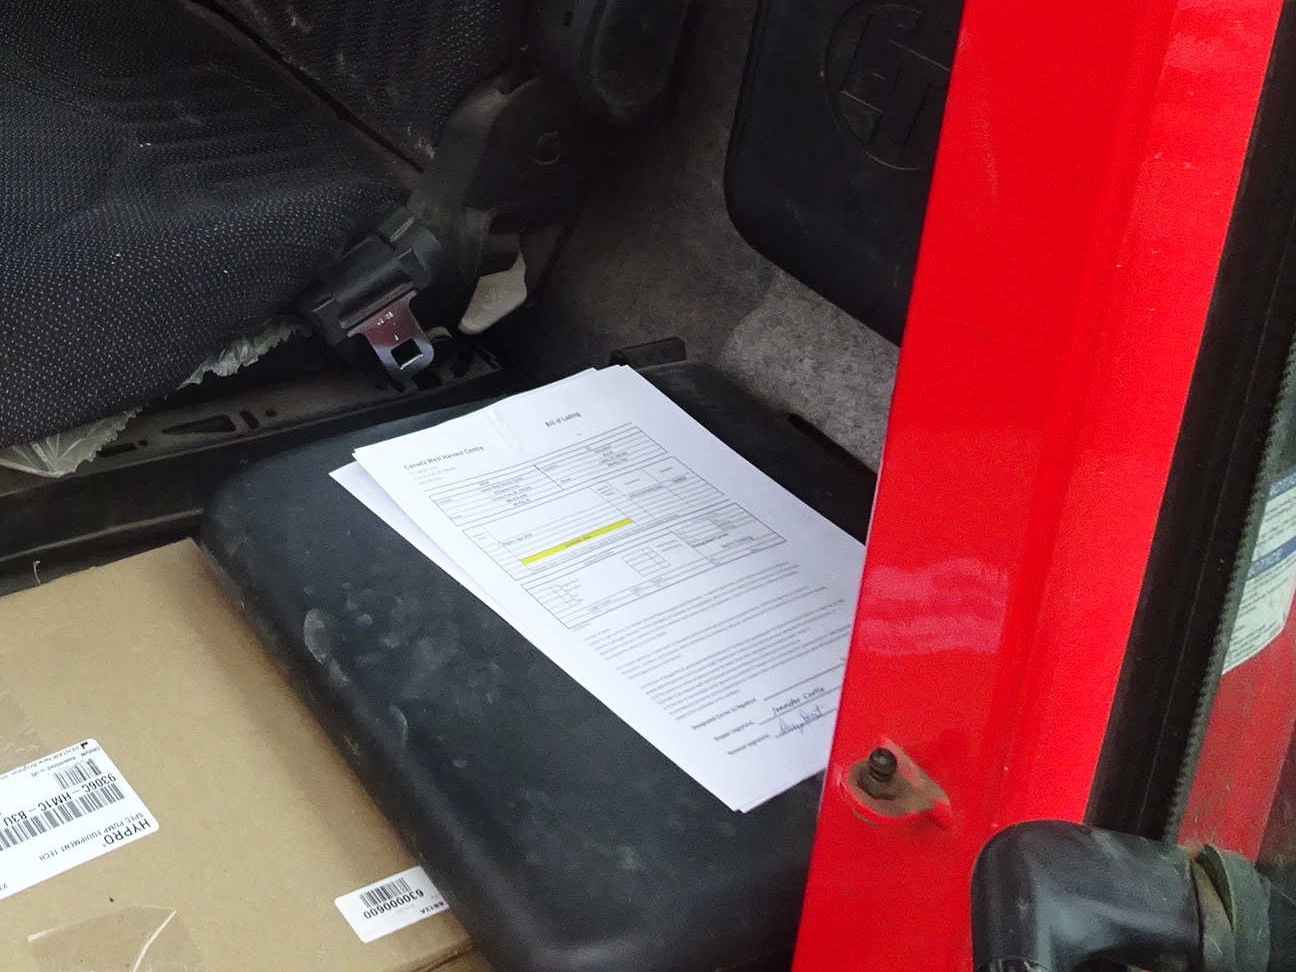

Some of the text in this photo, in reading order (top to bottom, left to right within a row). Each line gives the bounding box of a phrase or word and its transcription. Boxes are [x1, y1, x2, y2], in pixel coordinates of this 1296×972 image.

[404, 446, 484, 470] Canada West Harvest Centre
[39, 811, 144, 862] SPEC PUMP EQUIPMENT TECH
[104, 818, 151, 845] HYPRO
